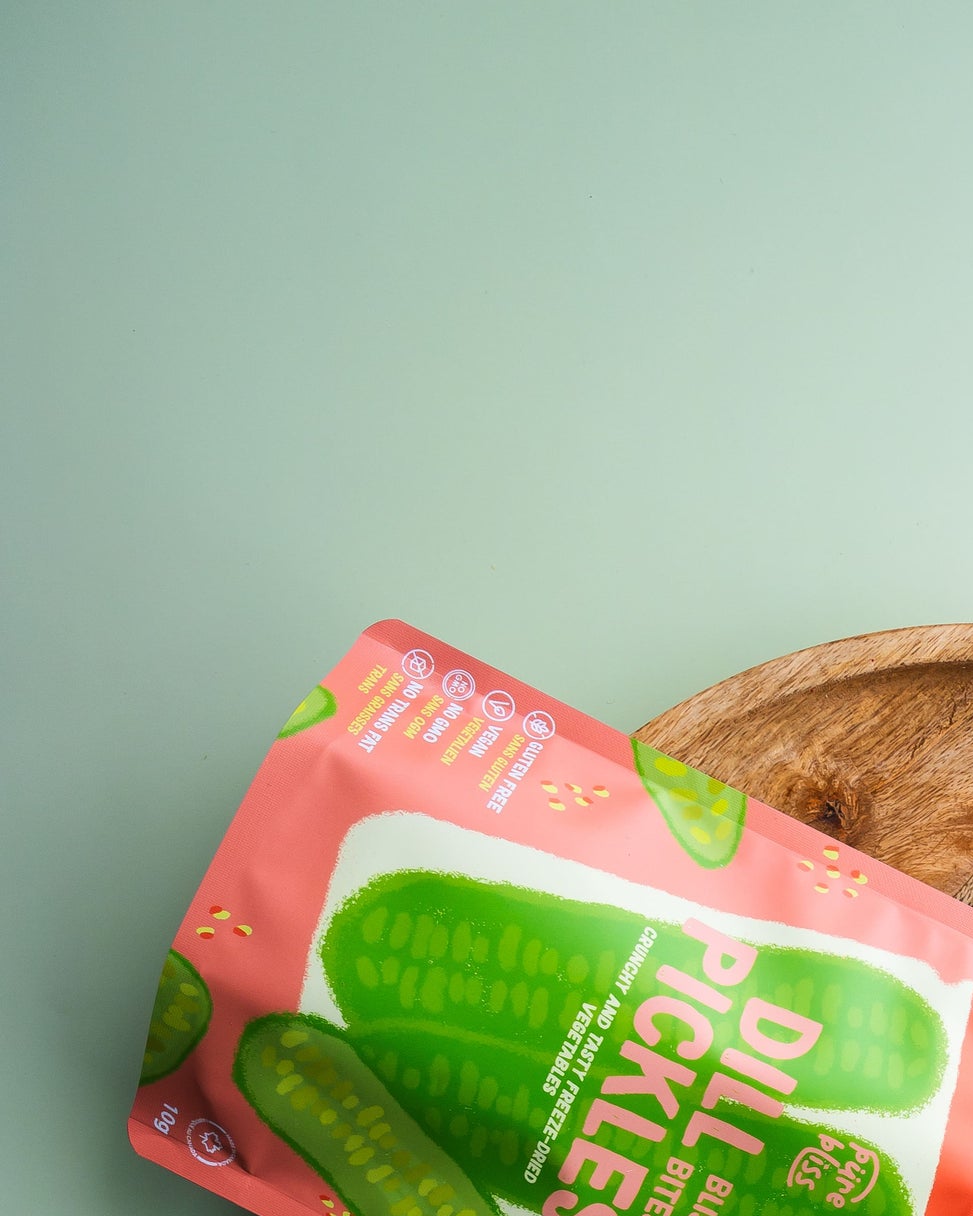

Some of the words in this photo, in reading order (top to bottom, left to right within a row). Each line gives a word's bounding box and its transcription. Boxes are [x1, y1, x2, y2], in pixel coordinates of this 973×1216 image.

[357, 663, 387, 694] TRANS
[379, 672, 405, 698] SANS
[402, 680, 424, 699] NO
[449, 674, 463, 693] GMO
[457, 680, 469, 693] NO
[347, 695, 385, 736] GRAISSES
[374, 699, 410, 732] TRANS
[421, 694, 444, 718] SANS
[443, 703, 464, 720] NO
[357, 729, 382, 753] FAT
[403, 716, 425, 740] OGM
[422, 717, 450, 743] GMO
[468, 725, 503, 758] VEGAN
[503, 734, 526, 759] SANS
[508, 742, 544, 781] GLUTEN
[478, 757, 509, 792] GLUTEN
[486, 779, 517, 814] FREE
[615, 926, 658, 996] CRUNCHY
[596, 993, 621, 1030] AND
[542, 1002, 598, 1097] VEGETABLES
[572, 1032, 604, 1082] TASTY
[681, 996, 824, 1155] DILL
[153, 1103, 179, 1135] 10g
[524, 1079, 580, 1184] FREEZE-DRIED
[786, 1133, 846, 1192] bliss
